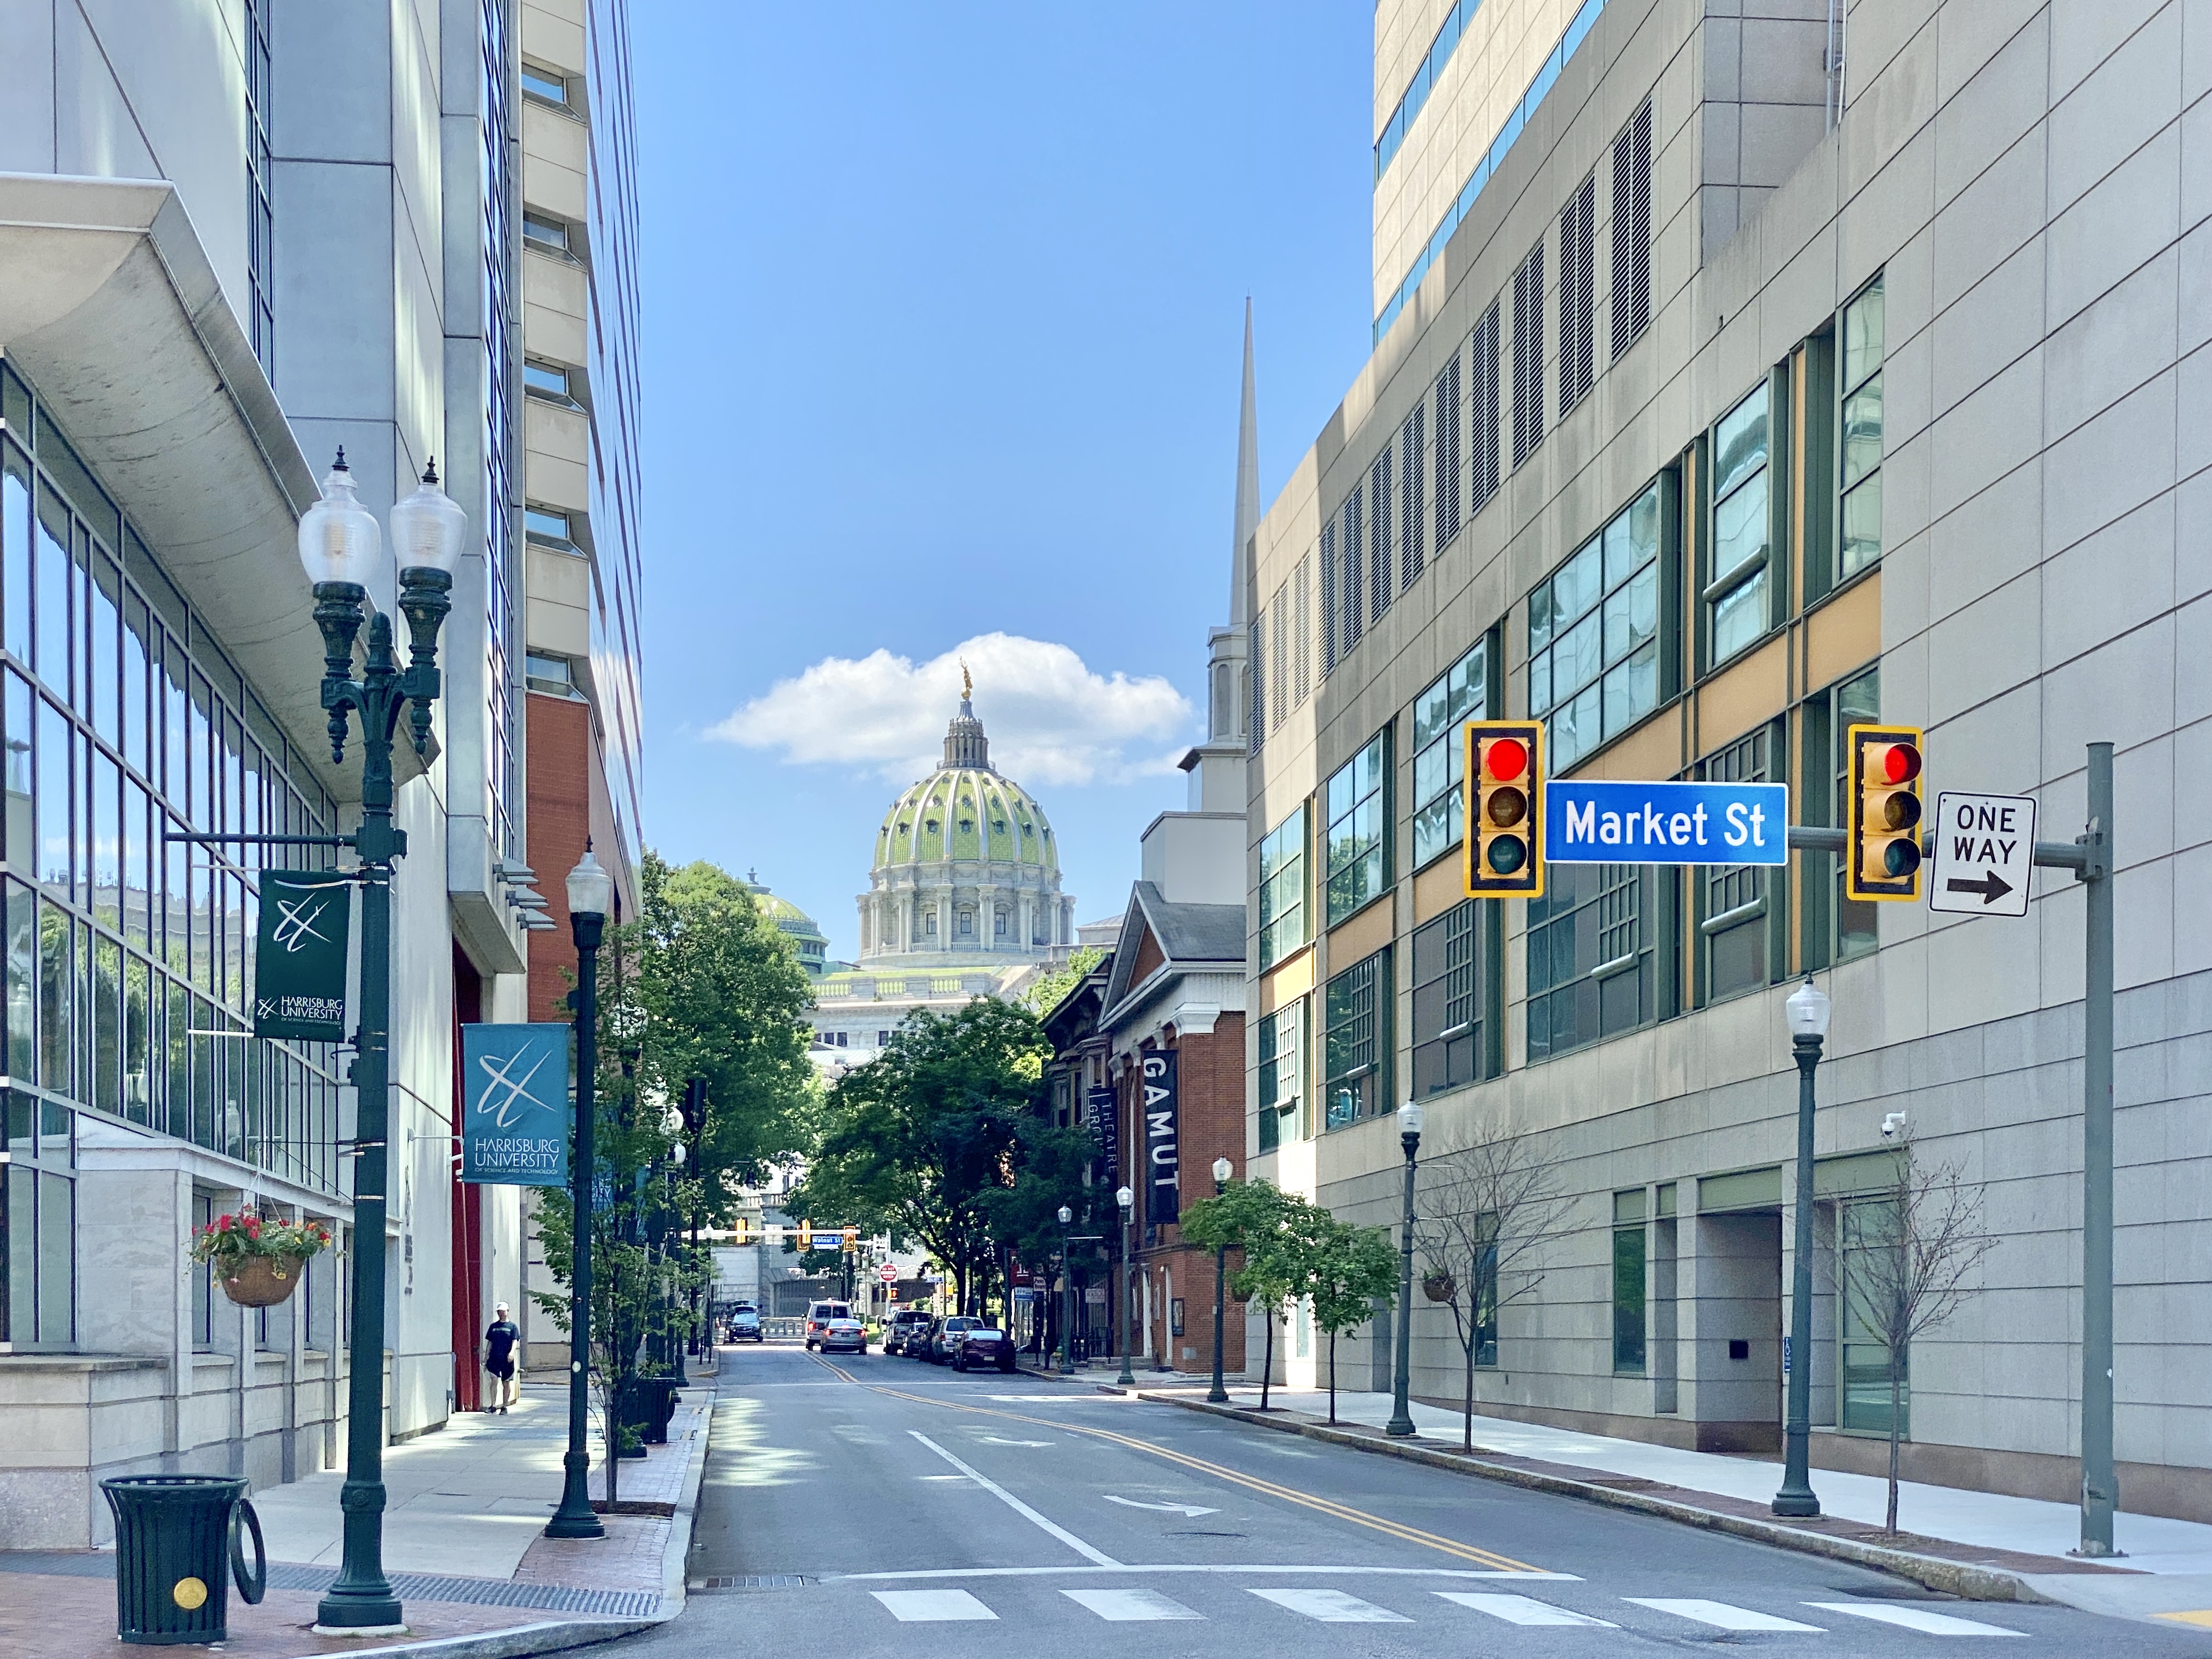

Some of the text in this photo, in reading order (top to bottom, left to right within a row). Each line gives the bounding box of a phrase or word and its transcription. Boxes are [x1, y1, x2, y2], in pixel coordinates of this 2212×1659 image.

[1566, 800, 1766, 847] Market St
[1957, 804, 2016, 833] ONE
[1954, 836, 2018, 865] WAY
[281, 995, 343, 1010] HARRISBURG
[281, 1006, 342, 1020] UNIVERSITY
[1102, 1101, 1118, 1174] THEATRE
[1143, 1057, 1179, 1190] GAMUT
[475, 1138, 560, 1154] HARRISBURG
[475, 1152, 559, 1168] UNIVERSITY
